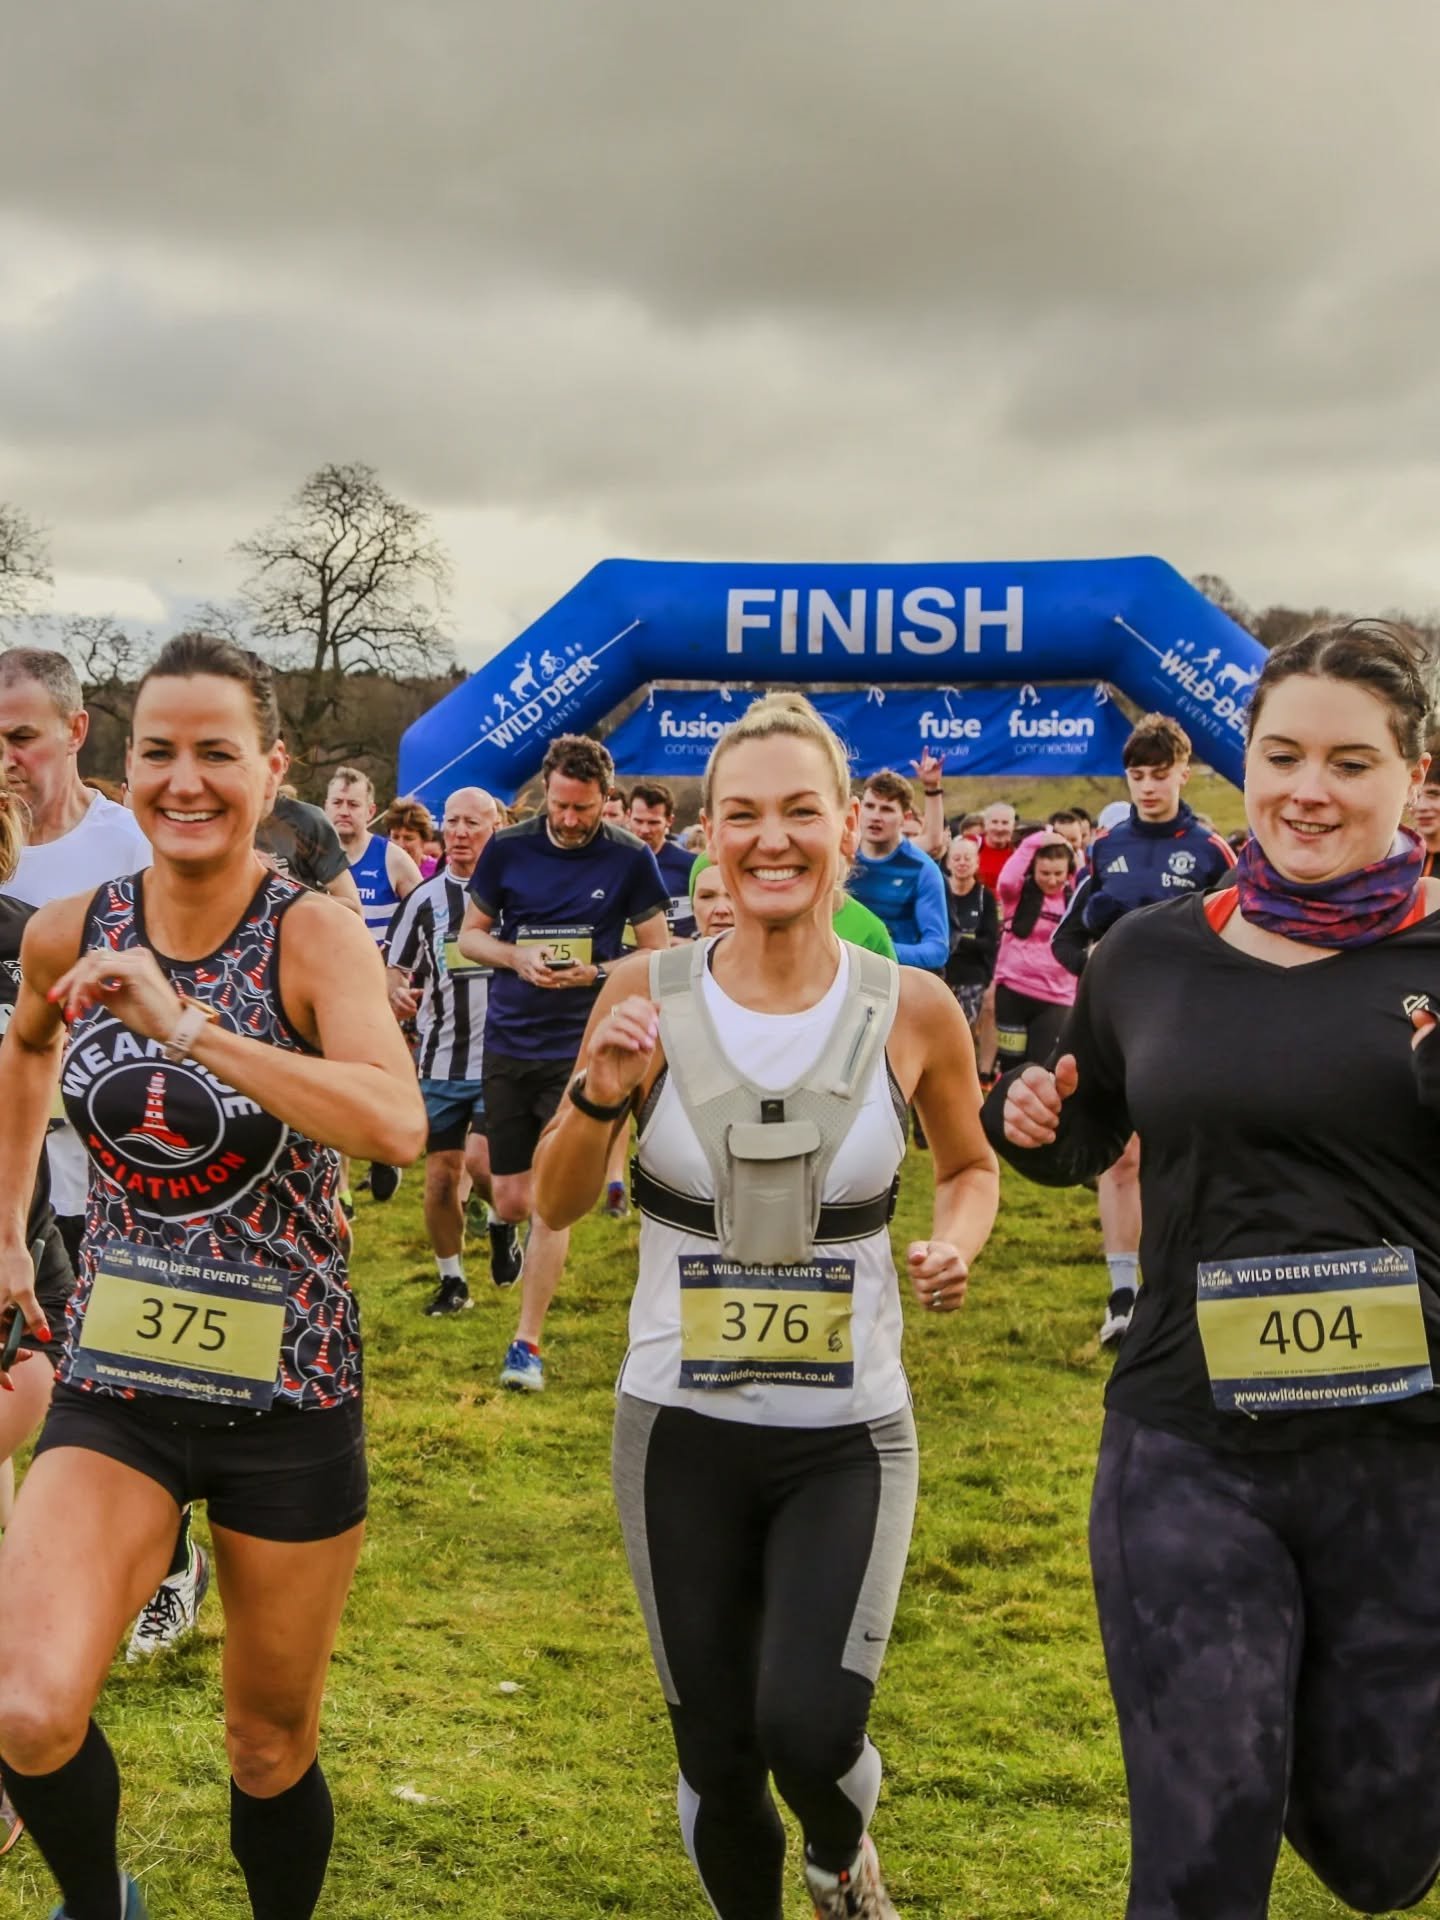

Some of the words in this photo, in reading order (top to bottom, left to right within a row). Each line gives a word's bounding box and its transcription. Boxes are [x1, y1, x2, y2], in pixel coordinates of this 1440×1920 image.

[726, 586, 1024, 655] FINISH
[486, 701, 543, 749] WILD
[541, 655, 600, 708] DEER
[1160, 648, 1216, 701] WILD
[1212, 695, 1250, 747] DE
[1176, 695, 1224, 737] EVENTS
[535, 698, 581, 738] EVENTS
[919, 711, 982, 739] fuse
[1009, 709, 1095, 738] fusion
[1014, 739, 1088, 755] connected
[548, 943, 571, 961] 75
[89, 1133, 247, 1199] TRIATHLON
[137, 1256, 167, 1272] WILD
[169, 1260, 201, 1278] DEER
[203, 1268, 250, 1286] EVENTS
[712, 1263, 742, 1275] WILD
[779, 1266, 823, 1278] EVENTS
[1237, 1267, 1272, 1283] WILD
[1275, 1264, 1310, 1280] DEER
[1314, 1260, 1367, 1277] EVENTS
[136, 1297, 227, 1352] 375
[721, 1300, 809, 1344] 376
[1259, 1304, 1363, 1355] 404
[95, 1363, 252, 1400] www.wilddeerevents.co.uk
[692, 1369, 836, 1383] www.wilddeerevents.co.uk
[1234, 1377, 1409, 1406] www.wilddeerevents.co.uk
